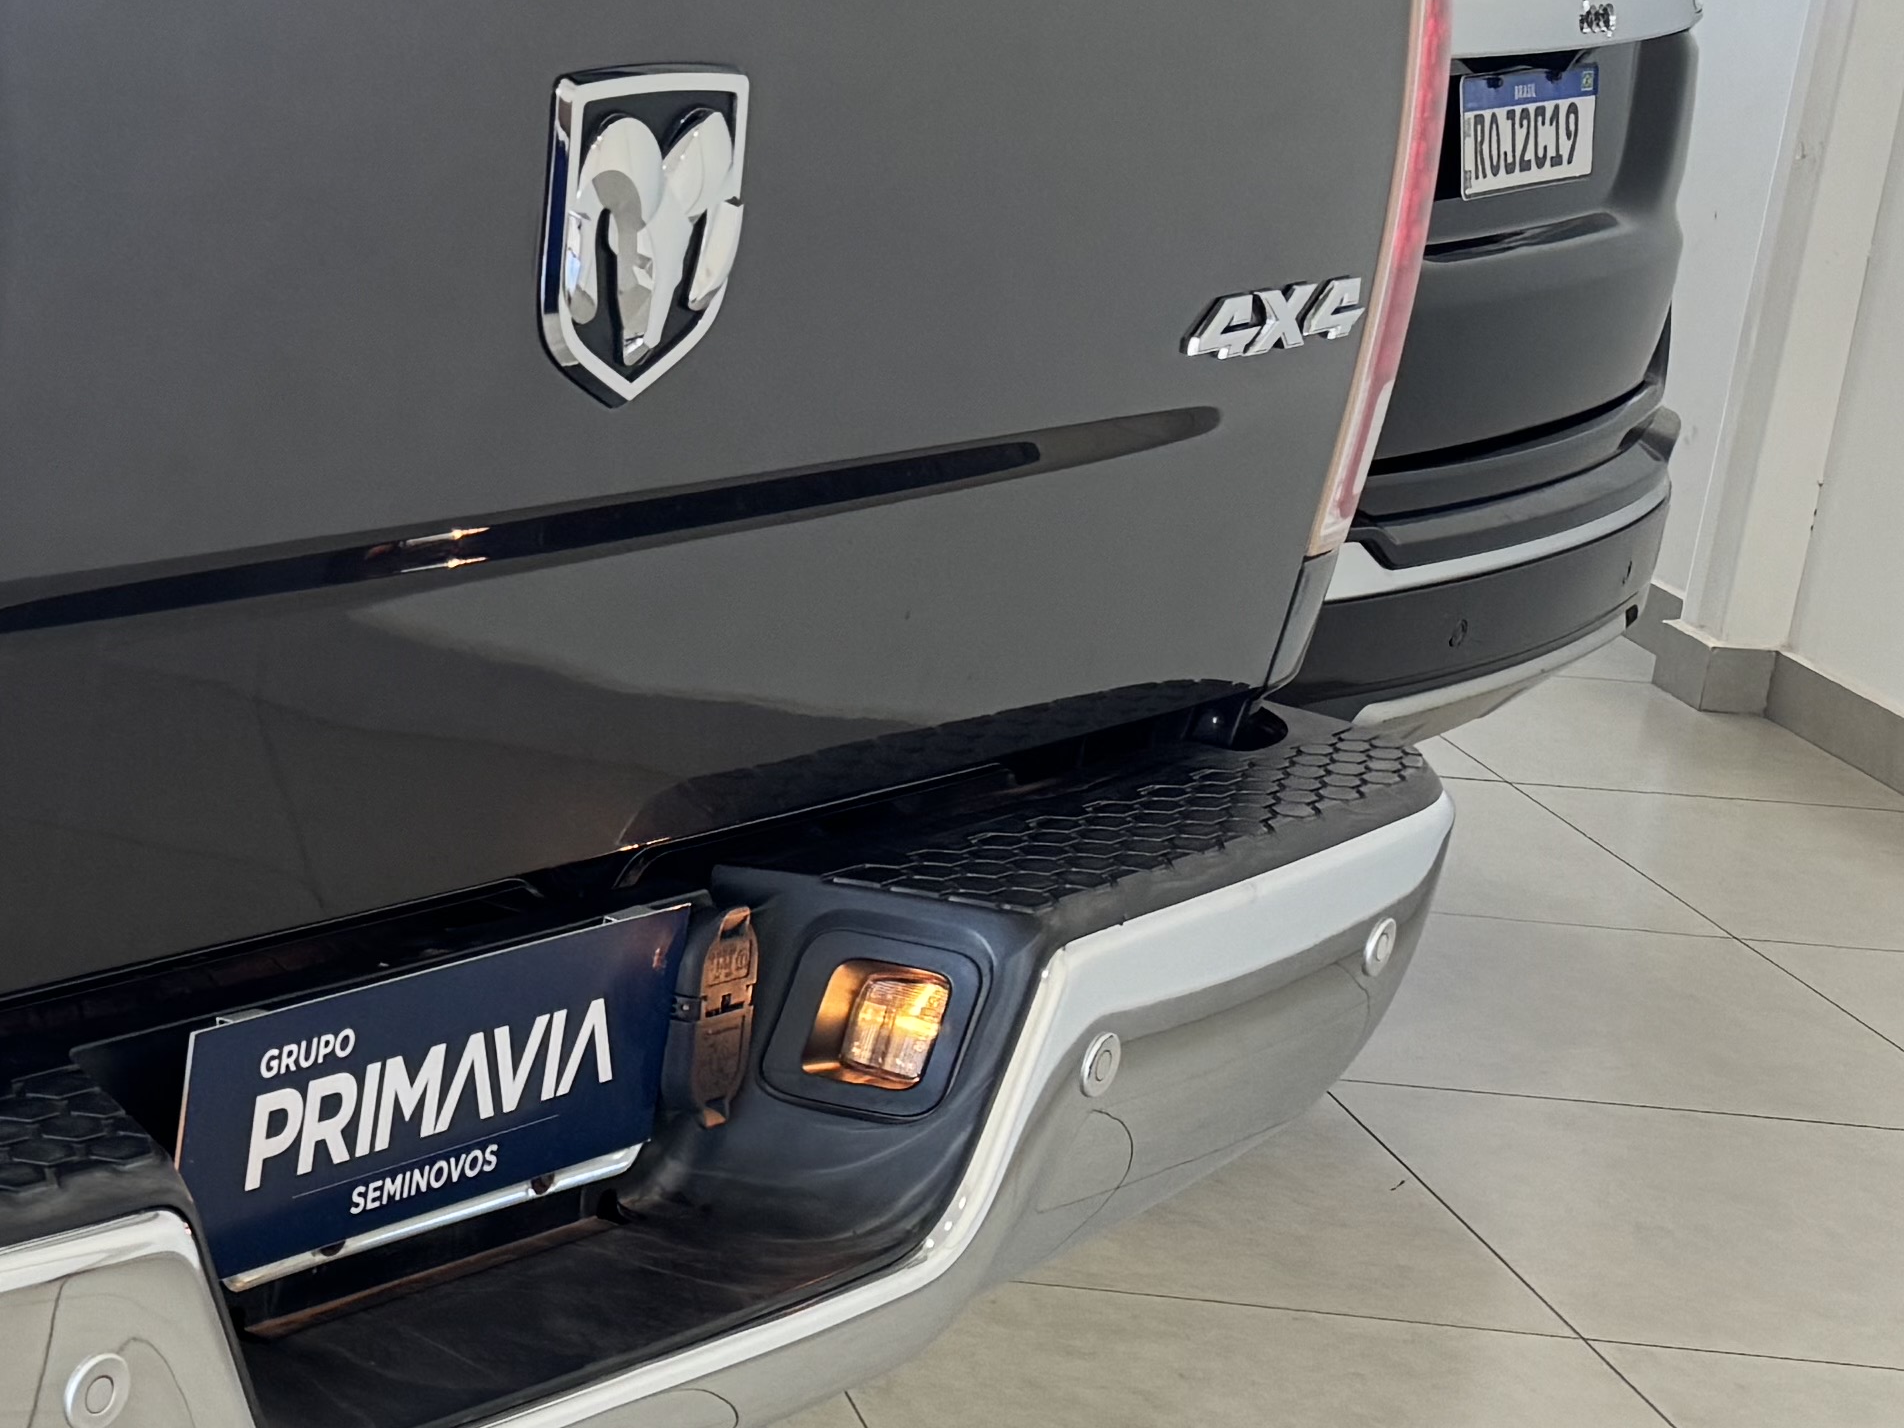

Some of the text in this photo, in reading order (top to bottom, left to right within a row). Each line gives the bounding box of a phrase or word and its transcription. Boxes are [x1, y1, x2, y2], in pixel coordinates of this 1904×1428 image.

[1473, 101, 1579, 180] ROJ2C19
[259, 1027, 356, 1079] GRUPO
[244, 998, 613, 1192] PRIMAVIA
[349, 1144, 499, 1216] SEMINOVOS
